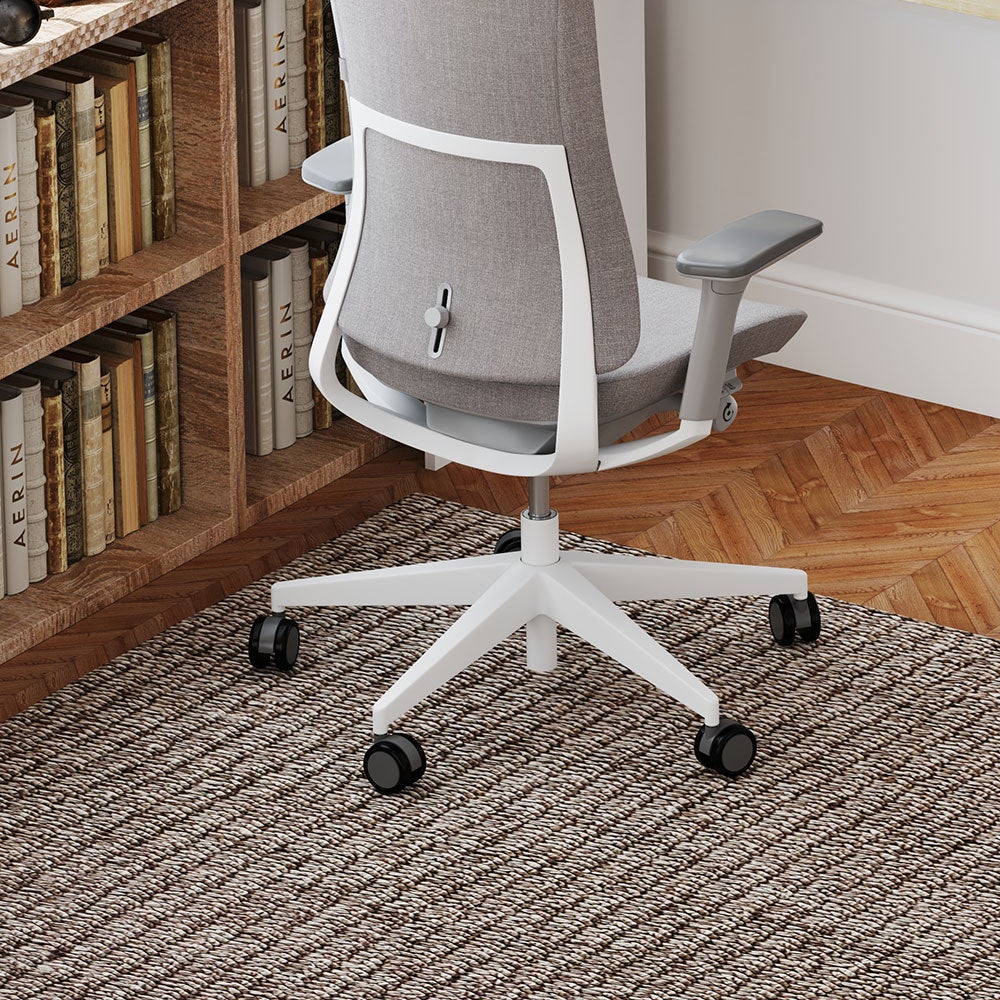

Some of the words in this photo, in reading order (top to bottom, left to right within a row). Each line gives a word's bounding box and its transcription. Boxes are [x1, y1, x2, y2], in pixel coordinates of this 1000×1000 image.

[273, 30, 288, 134] AERIN
[4, 161, 19, 269] AERIN
[280, 301, 294, 403] AERIN
[10, 443, 26, 547] AERIN
